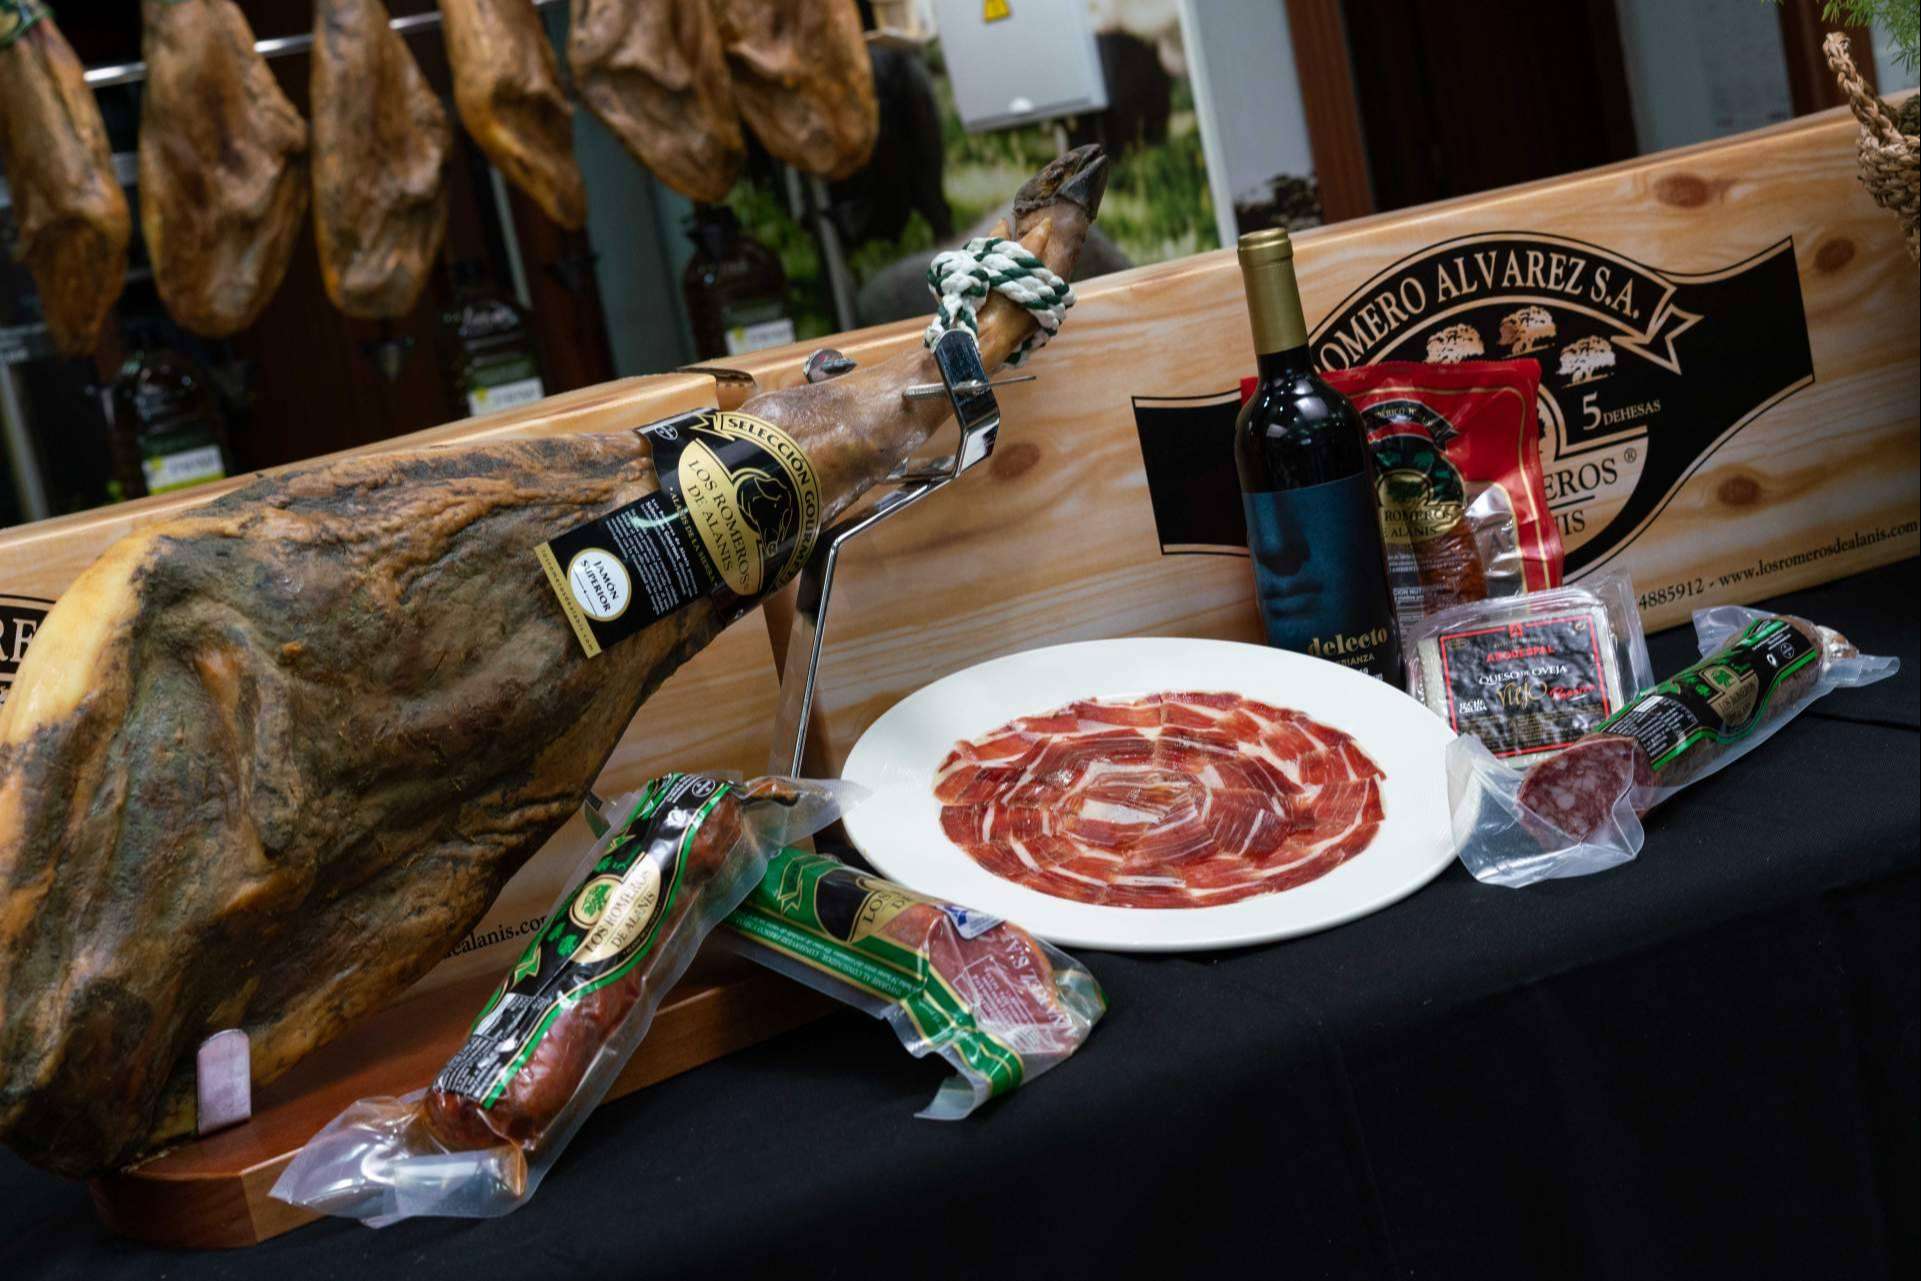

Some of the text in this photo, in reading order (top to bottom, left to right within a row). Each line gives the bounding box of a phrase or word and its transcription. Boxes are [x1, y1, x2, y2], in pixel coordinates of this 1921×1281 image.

[1313, 250, 1641, 373] OMERO ALVAREZ S.A.
[1582, 391, 1662, 431] 5 DEHESAS
[728, 416, 812, 486] SELECCIÓN
[688, 459, 750, 591] LOS ROMEROS
[701, 507, 734, 573] ALANIS
[593, 560, 619, 601] JAMÓN
[1719, 519, 1919, 587] www.losromerosdealanis.com
[580, 558, 612, 613] SUPERIOR
[1307, 627, 1388, 656] delecto
[1478, 670, 1520, 686] QUESO
[1531, 664, 1569, 677] OVEJA
[442, 914, 547, 960] ealanis.co
[585, 925, 608, 952] LOS
[611, 932, 627, 948] DE
[626, 893, 655, 929] ALANIS
